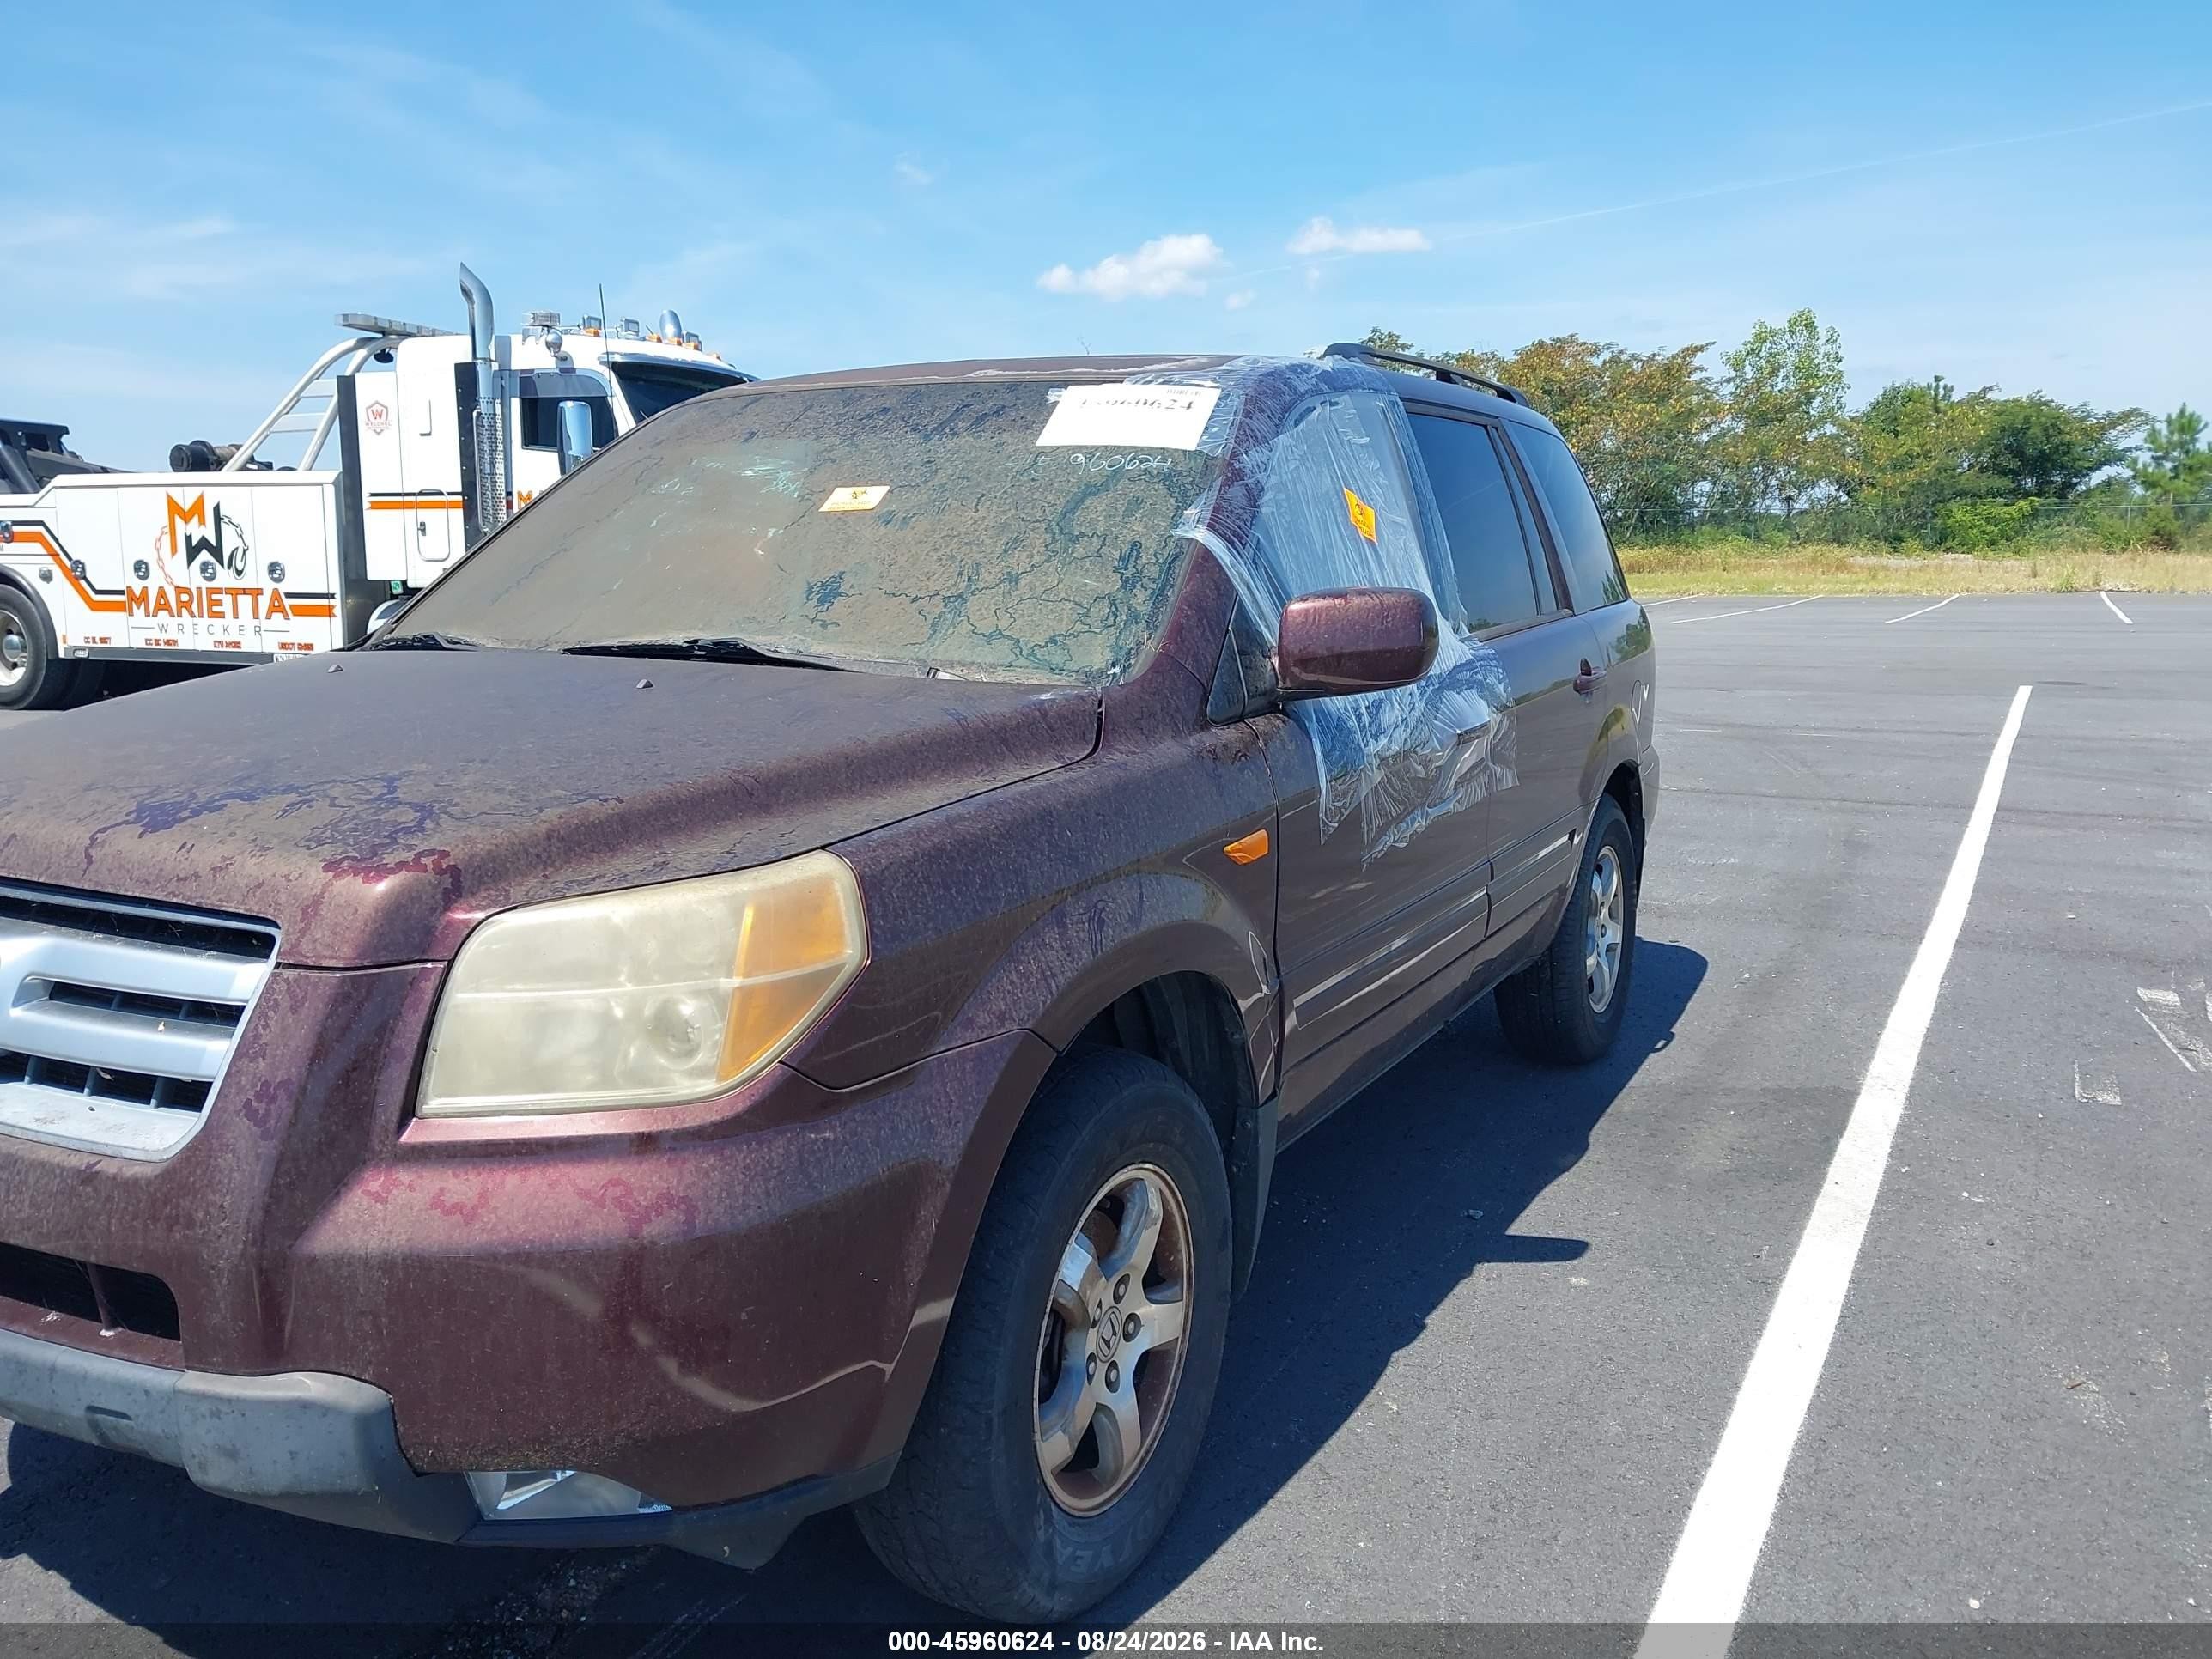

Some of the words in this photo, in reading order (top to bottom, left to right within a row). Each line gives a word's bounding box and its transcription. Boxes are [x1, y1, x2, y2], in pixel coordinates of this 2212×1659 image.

[1070, 452, 1173, 475] 960624
[126, 586, 290, 621] MARIETTA
[157, 623, 262, 637] WRECKER
